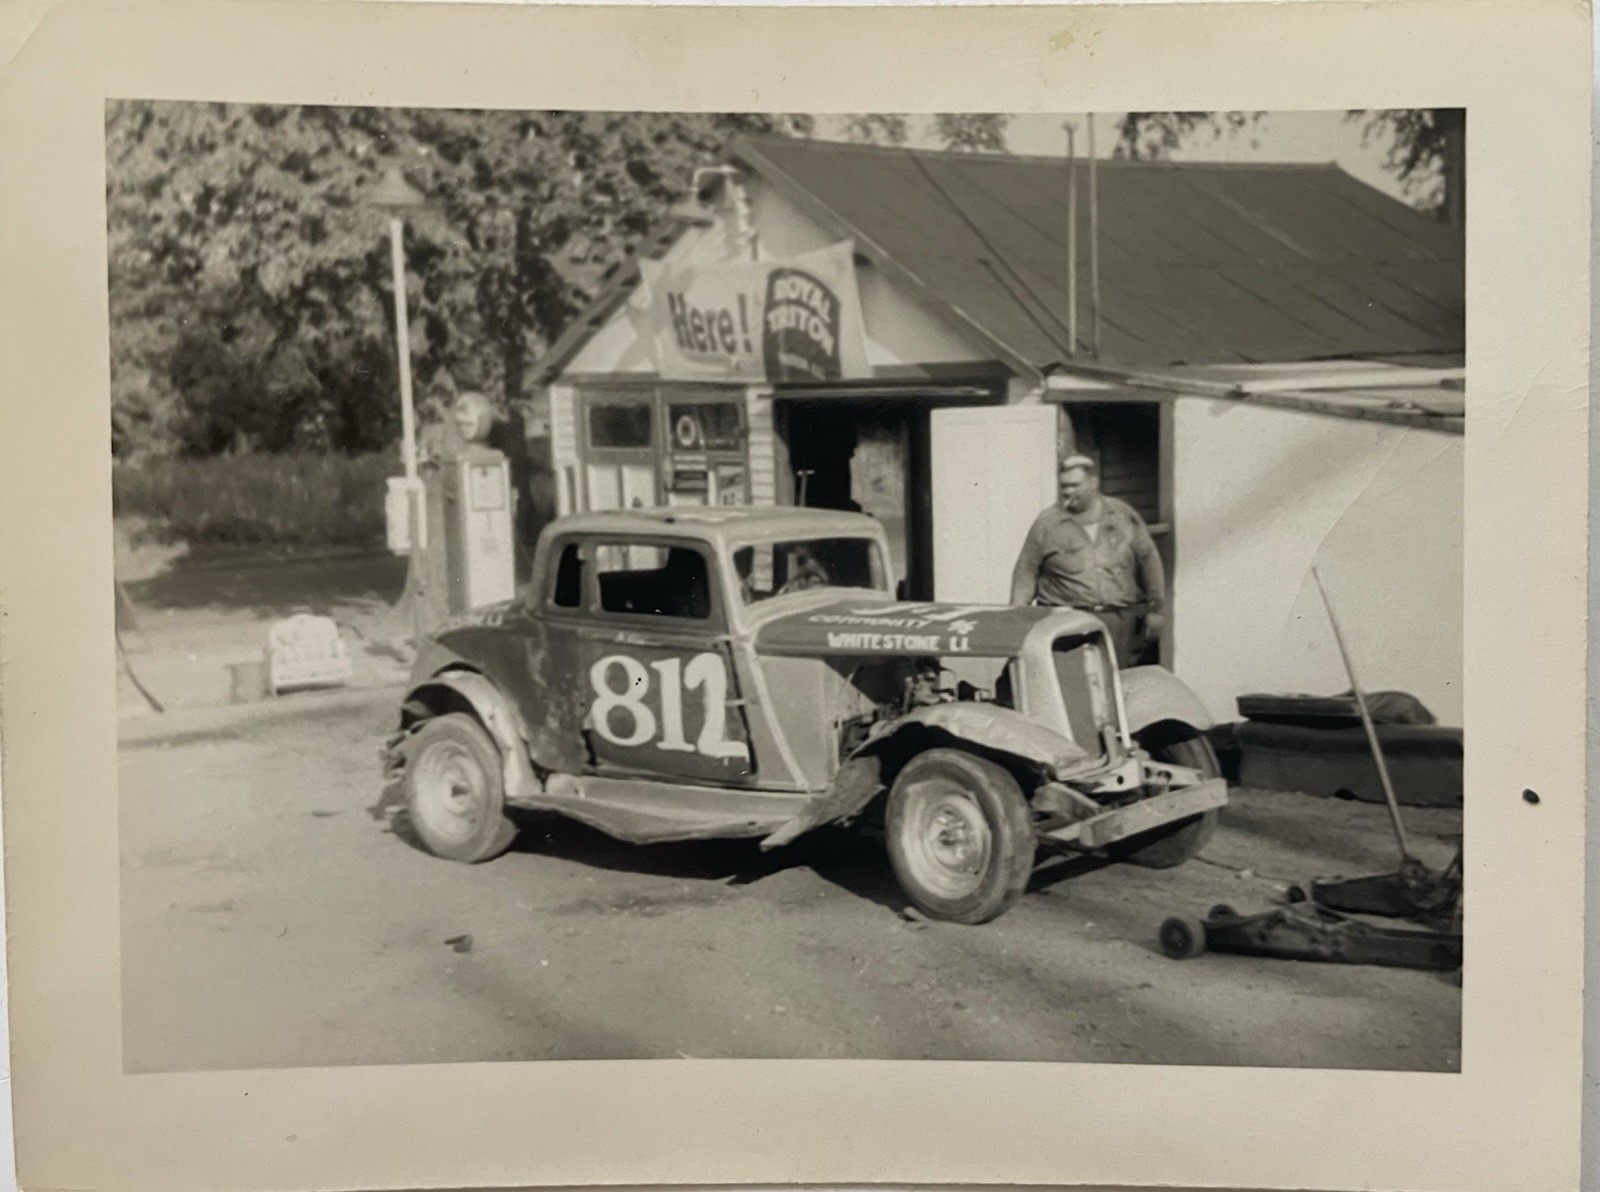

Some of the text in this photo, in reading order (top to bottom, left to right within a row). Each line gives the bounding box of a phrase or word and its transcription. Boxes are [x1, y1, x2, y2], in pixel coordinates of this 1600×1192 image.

[667, 292, 752, 354] Here!
[828, 632, 941, 650] WHITESTONE
[588, 652, 750, 762] 812
